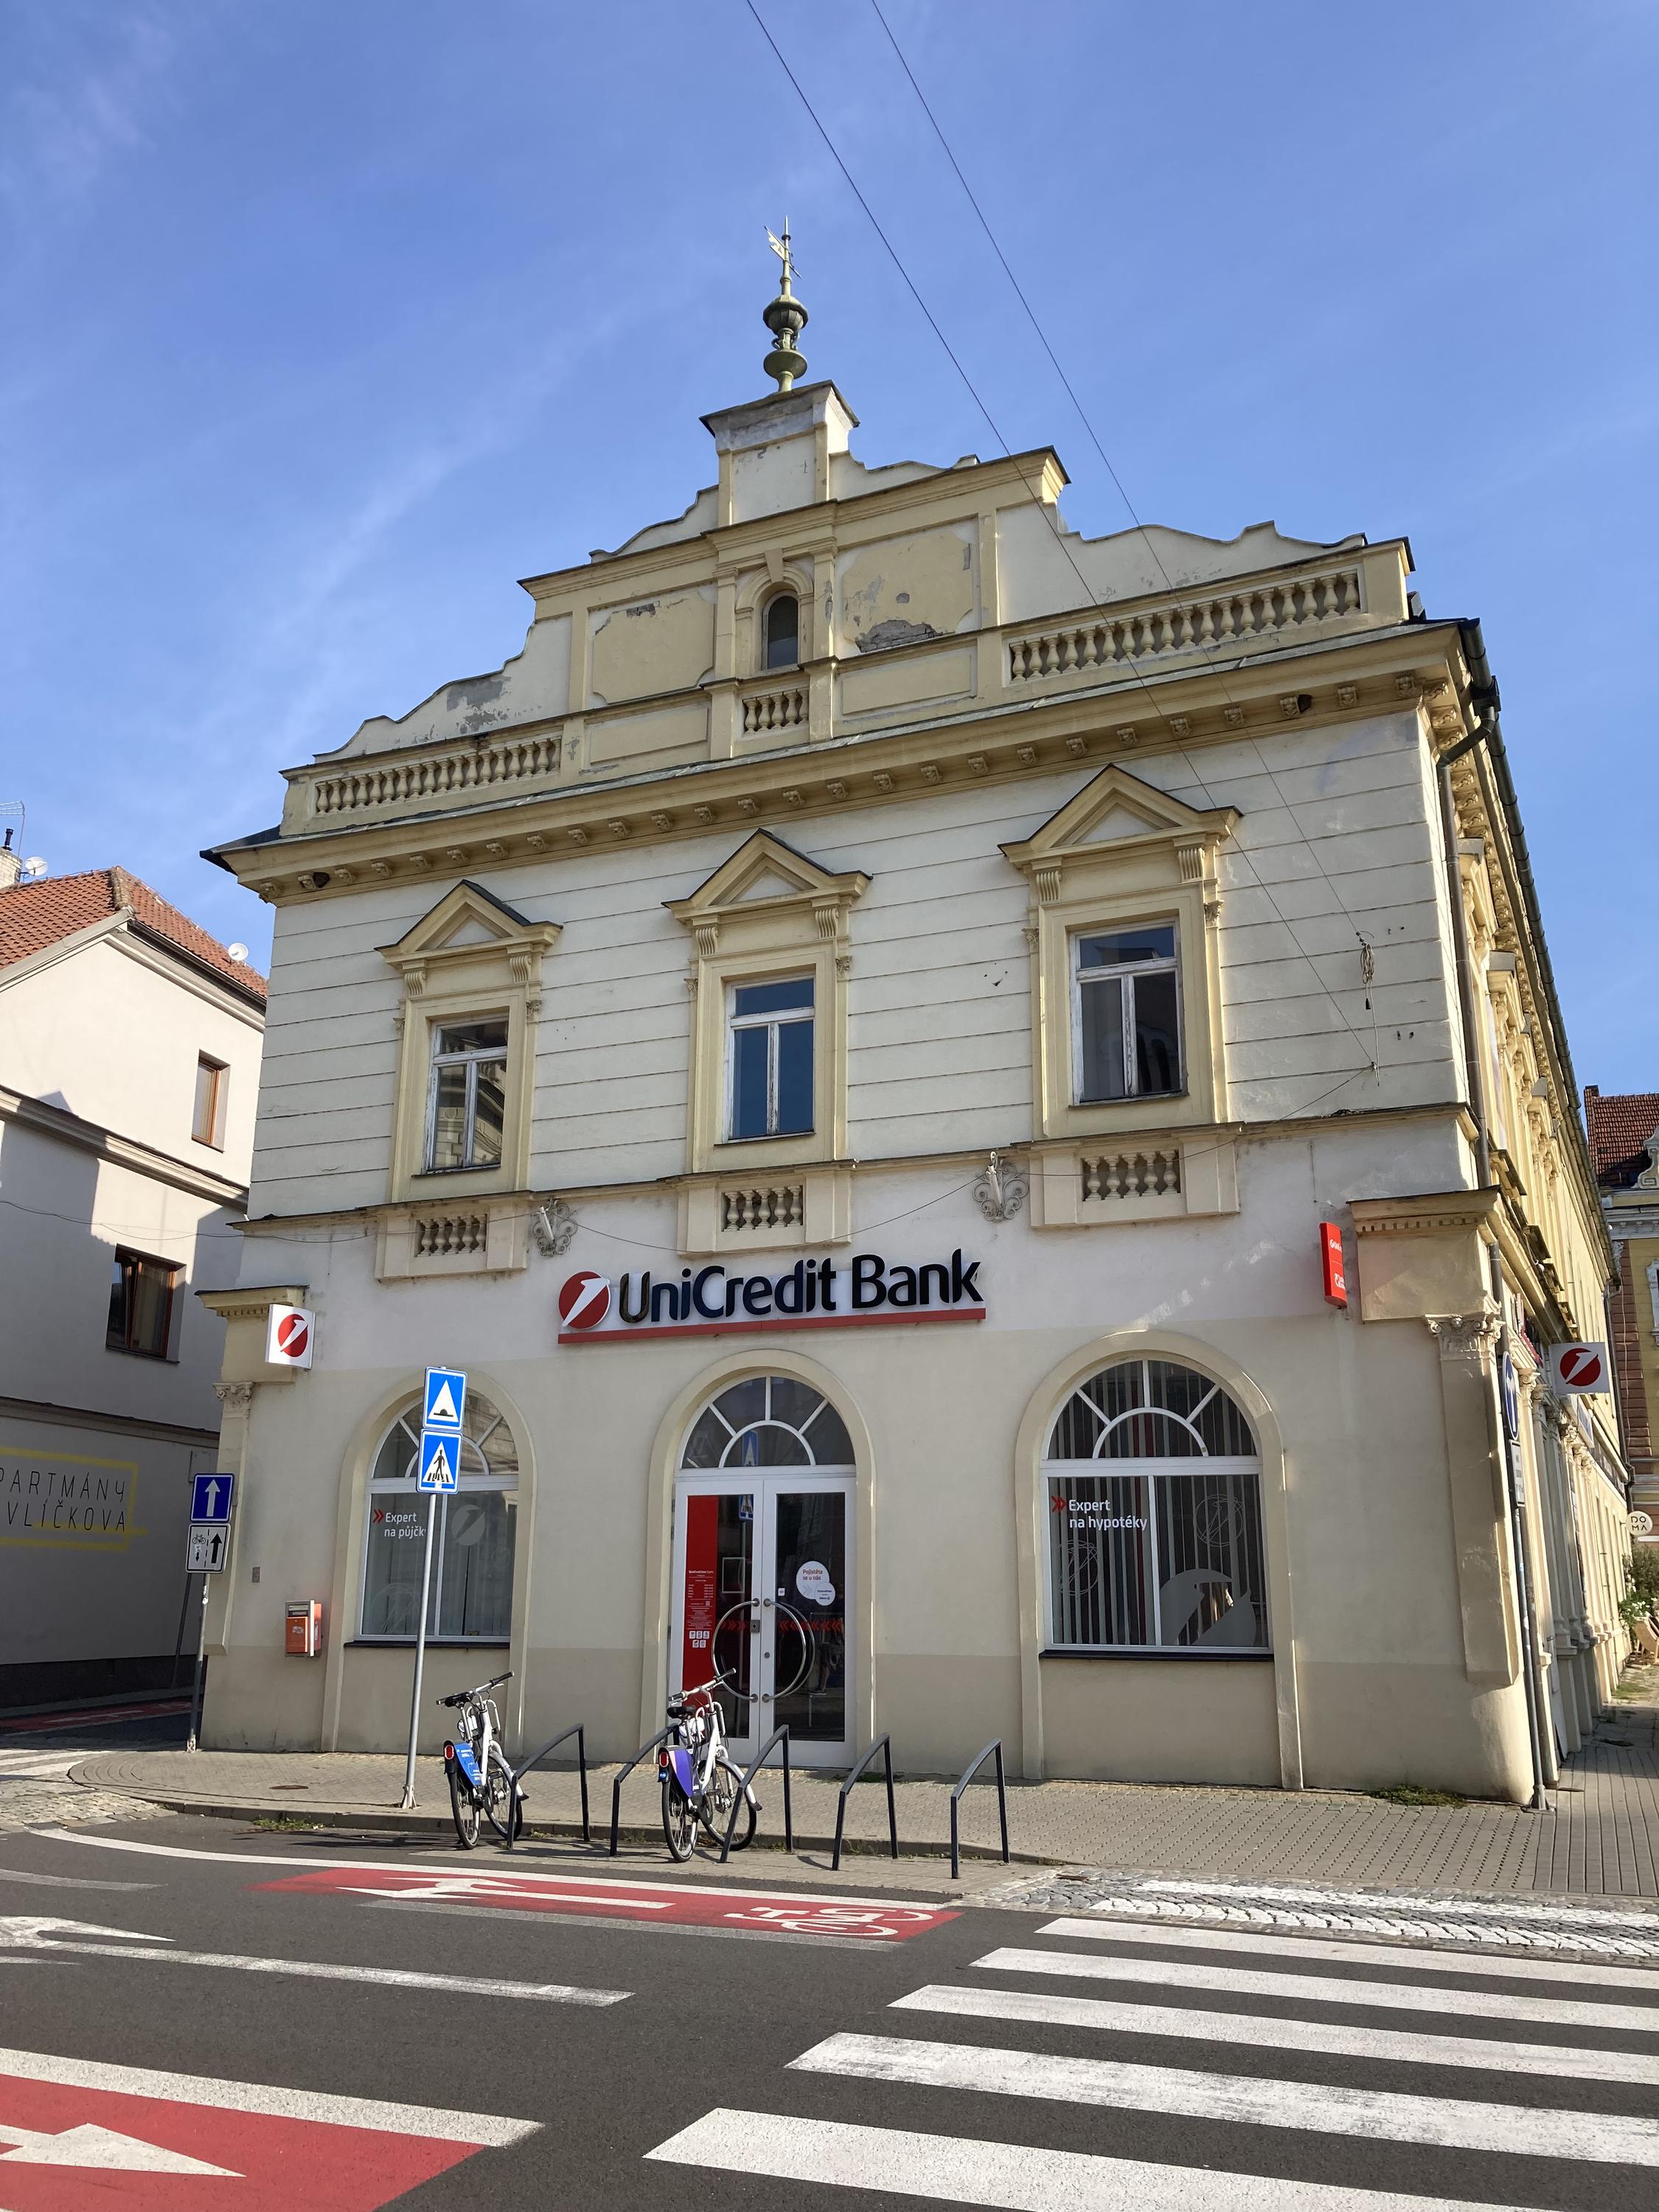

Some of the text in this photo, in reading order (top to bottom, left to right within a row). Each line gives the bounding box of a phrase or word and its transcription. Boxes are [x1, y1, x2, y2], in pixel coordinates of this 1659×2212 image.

[619, 1248, 984, 1323] UniCredit Bank
[1069, 1499, 1110, 1514] Expert
[386, 1512, 417, 1524] Expert
[1070, 1515, 1147, 1531] na hypotéky
[384, 1526, 426, 1539] na půjčk
